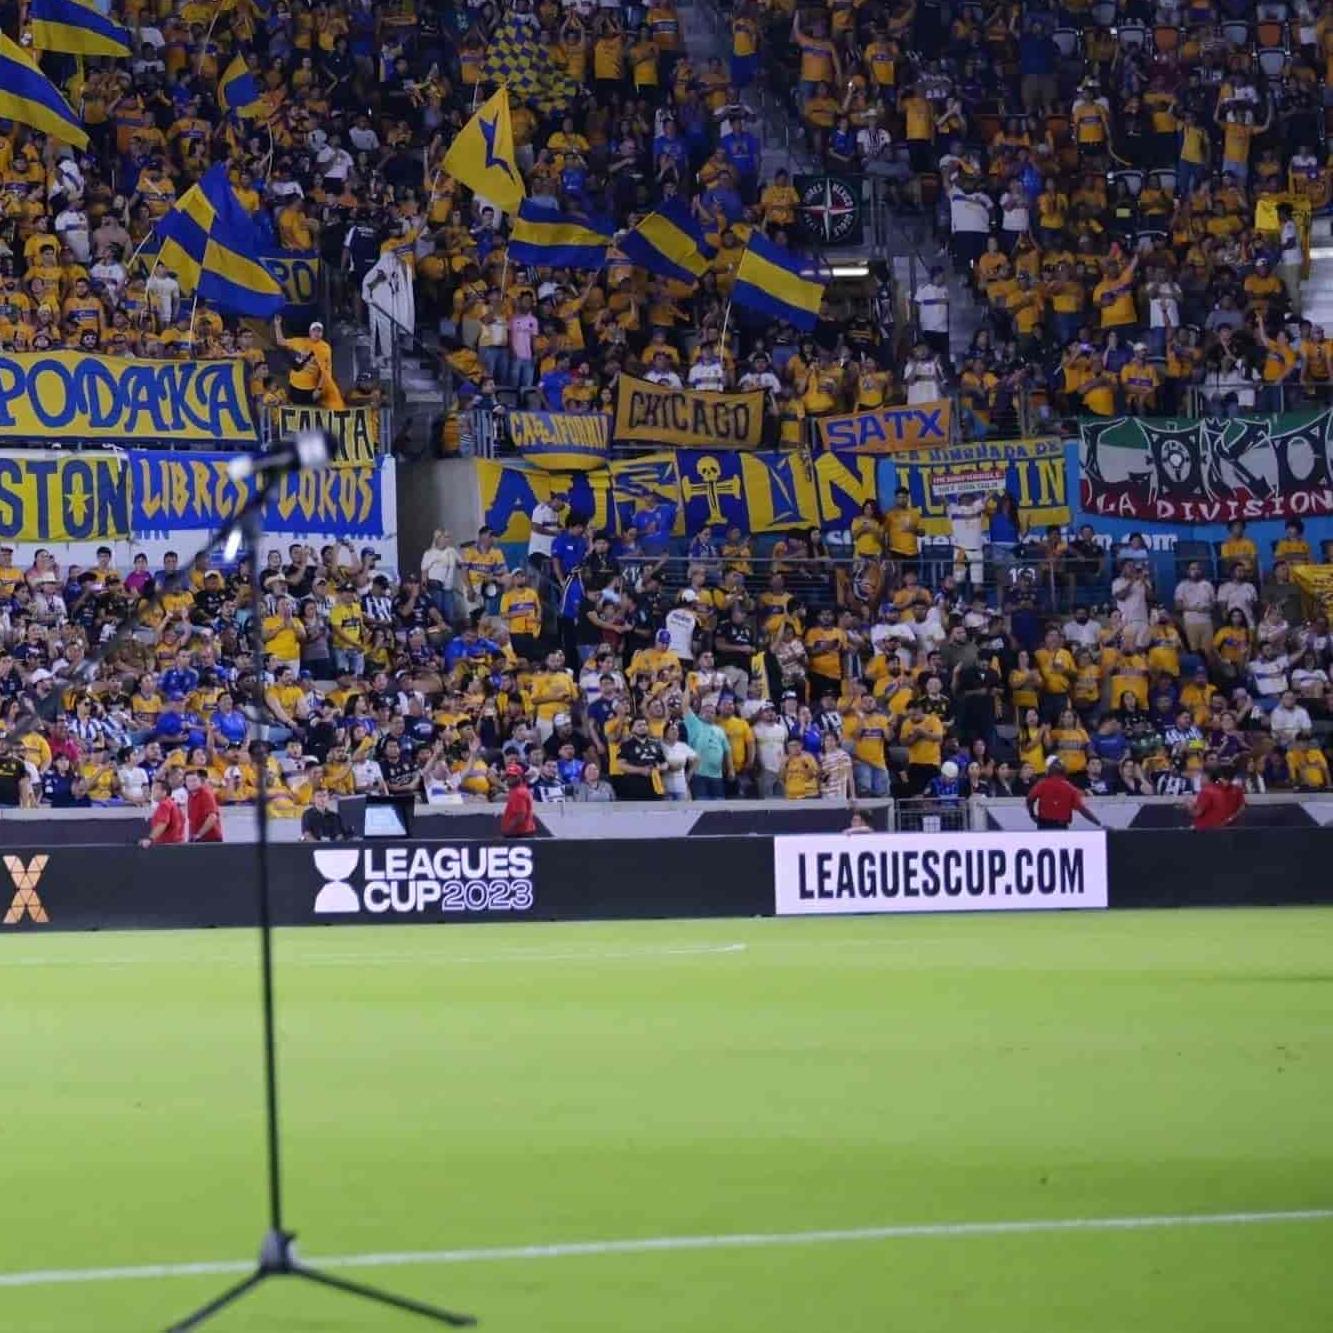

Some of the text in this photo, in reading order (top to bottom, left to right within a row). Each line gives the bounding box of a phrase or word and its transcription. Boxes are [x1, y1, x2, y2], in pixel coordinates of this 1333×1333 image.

[628, 389, 752, 442] CHICAGO
[827, 408, 946, 451] SATX
[140, 458, 247, 519] LIBRES
[276, 463, 374, 524] LOKOS
[1096, 489, 1333, 521] LA DIVISION
[364, 846, 533, 880] LEAGUES
[798, 848, 1085, 900] LEAGUESCUP.COM
[363, 879, 534, 913] CUP 2023
